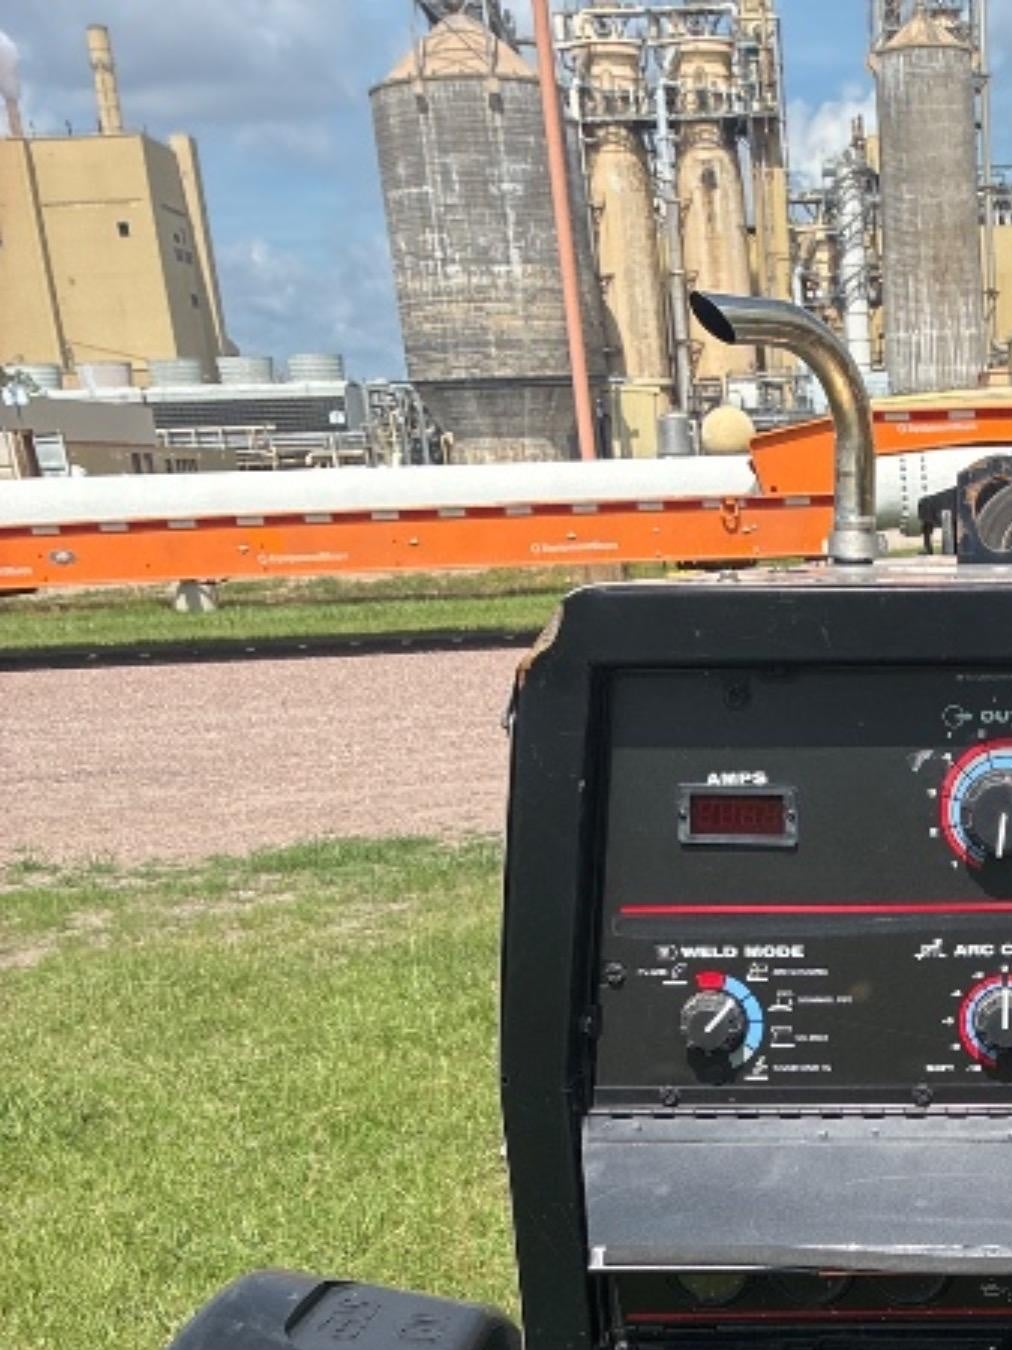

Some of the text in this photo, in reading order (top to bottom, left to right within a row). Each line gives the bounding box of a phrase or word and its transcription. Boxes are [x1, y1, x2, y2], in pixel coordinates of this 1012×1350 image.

[706, 771, 769, 786] AMPS
[681, 945, 805, 959] WELD MODE
[953, 943, 995, 957] ARC
